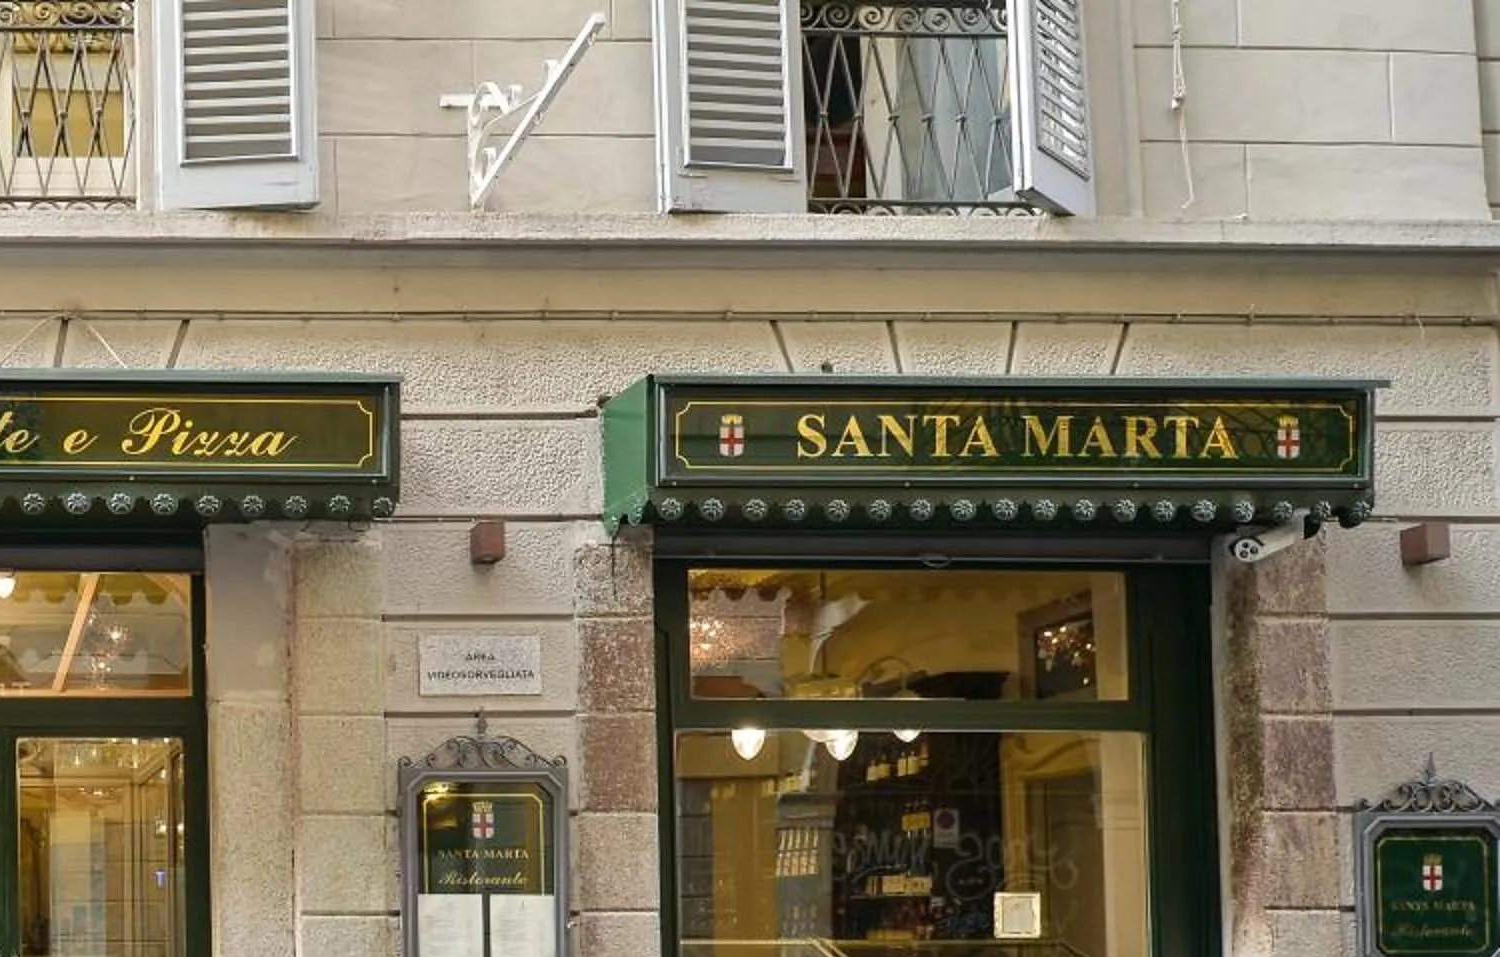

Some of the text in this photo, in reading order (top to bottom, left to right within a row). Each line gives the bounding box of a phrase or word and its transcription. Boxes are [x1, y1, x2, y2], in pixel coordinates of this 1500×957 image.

[62, 430, 98, 455] e
[120, 405, 299, 457] Pizza
[796, 412, 1240, 461] SANTA MARTA
[438, 848, 529, 860] SANTA MARTA
[439, 871, 529, 886] Ristorante
